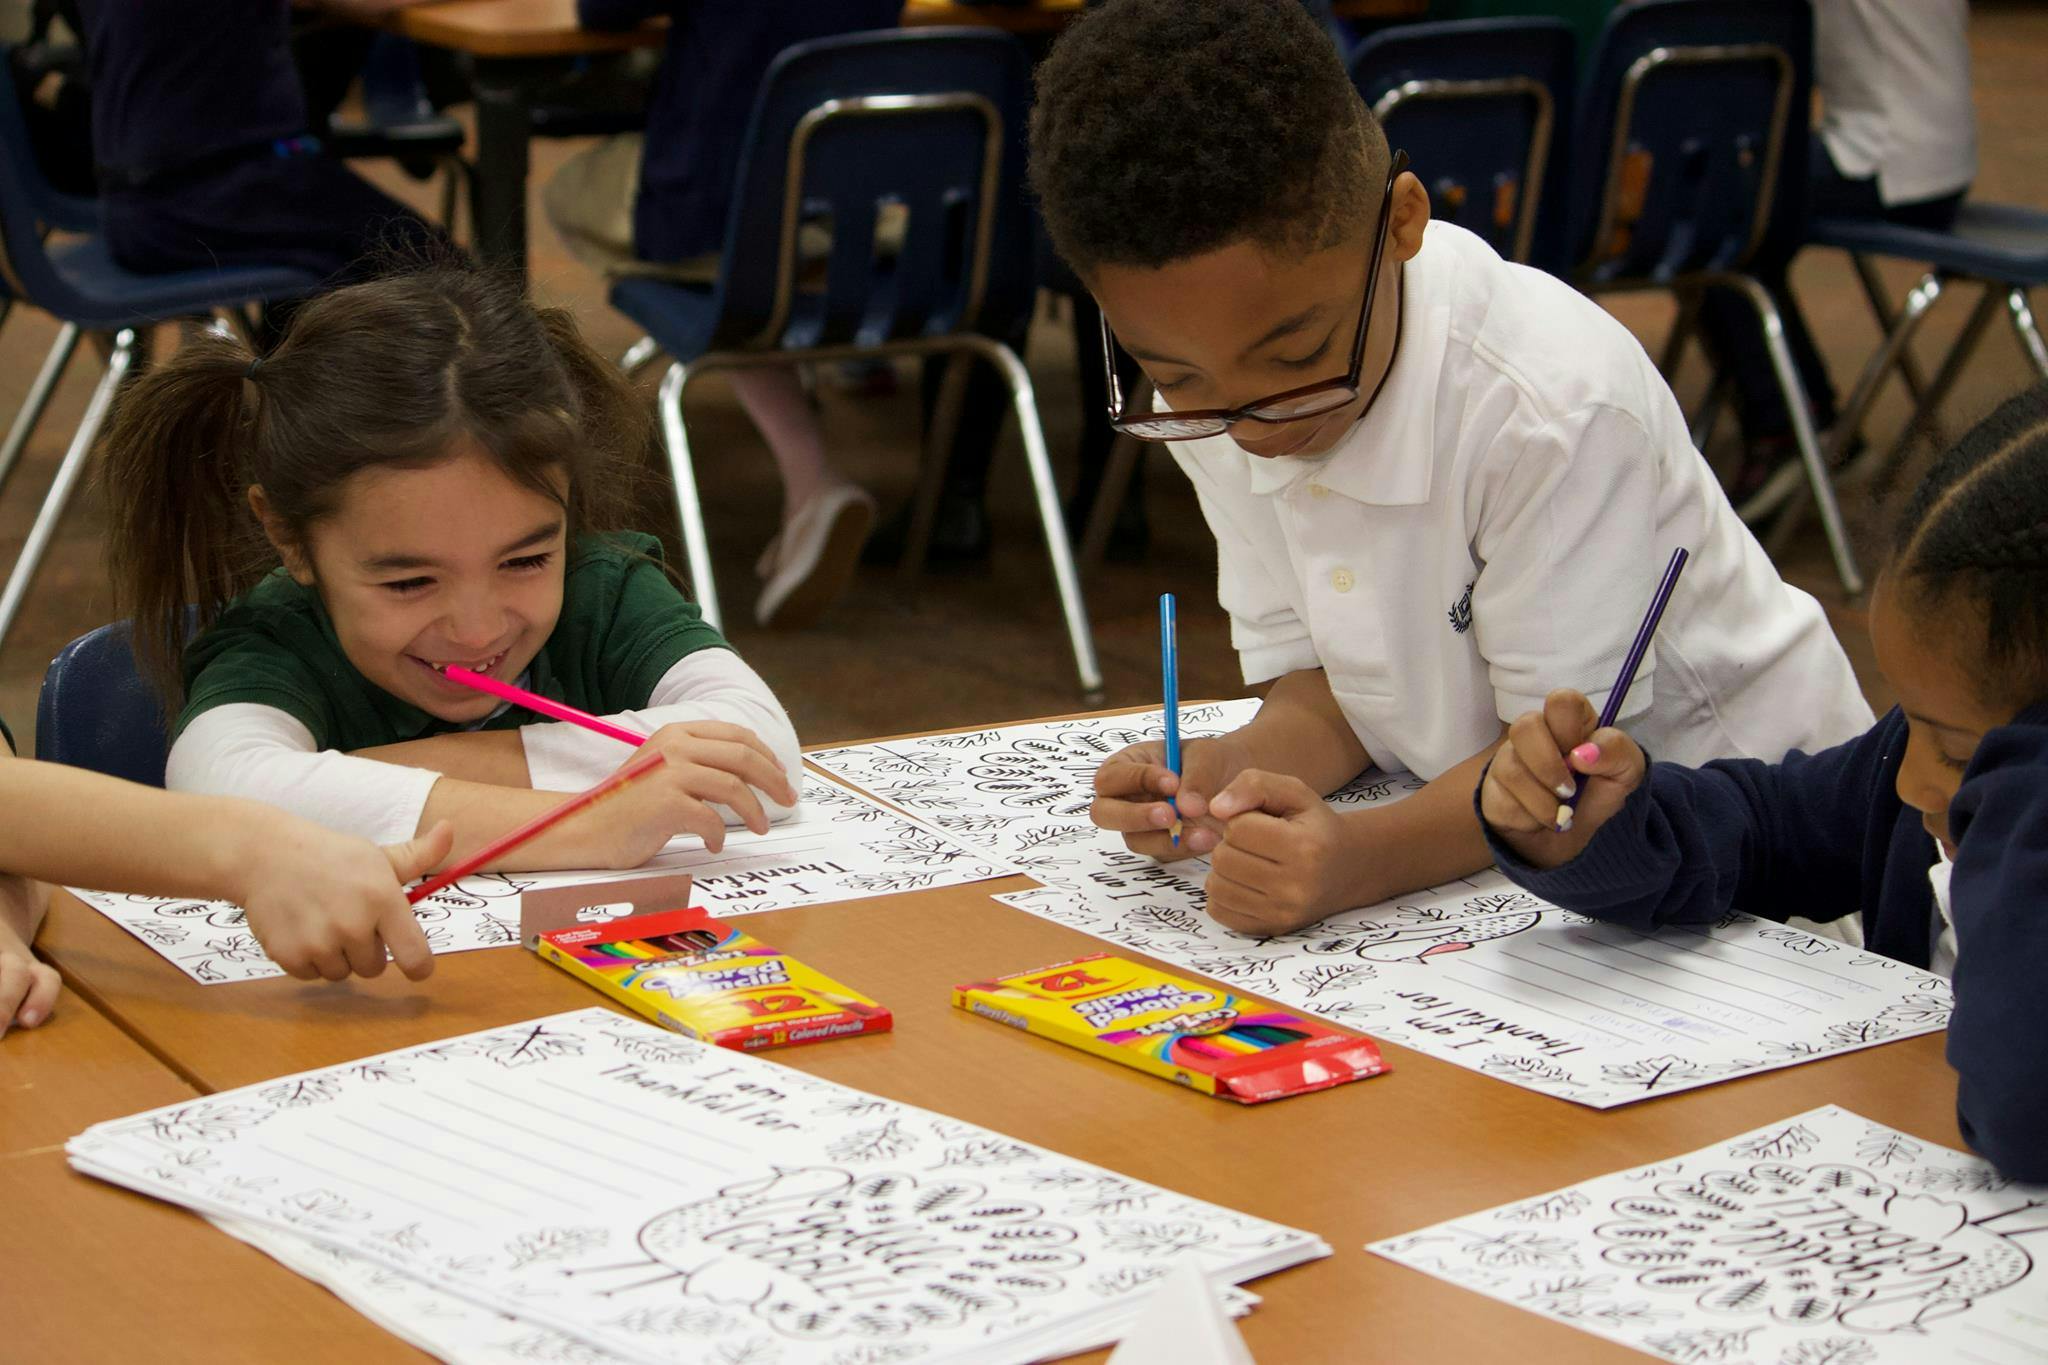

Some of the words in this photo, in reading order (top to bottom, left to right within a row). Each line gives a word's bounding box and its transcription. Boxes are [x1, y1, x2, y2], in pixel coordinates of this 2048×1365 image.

[692, 861, 854, 891] Thankful
[1088, 872, 1126, 888] am
[711, 889, 767, 901] am
[782, 881, 818, 896] I
[641, 960, 785, 990] Clored
[668, 973, 791, 999] Pncils
[1025, 970, 1110, 991] 12
[732, 994, 817, 1017] 12
[1072, 983, 1182, 1015] Pencils
[1084, 990, 1216, 1029] Colored
[1405, 1018, 1455, 1036] am
[1436, 1008, 1585, 1059] Thankful
[1444, 1038, 1493, 1051] I
[599, 1062, 757, 1115] Thankful
[736, 1081, 788, 1102] am
